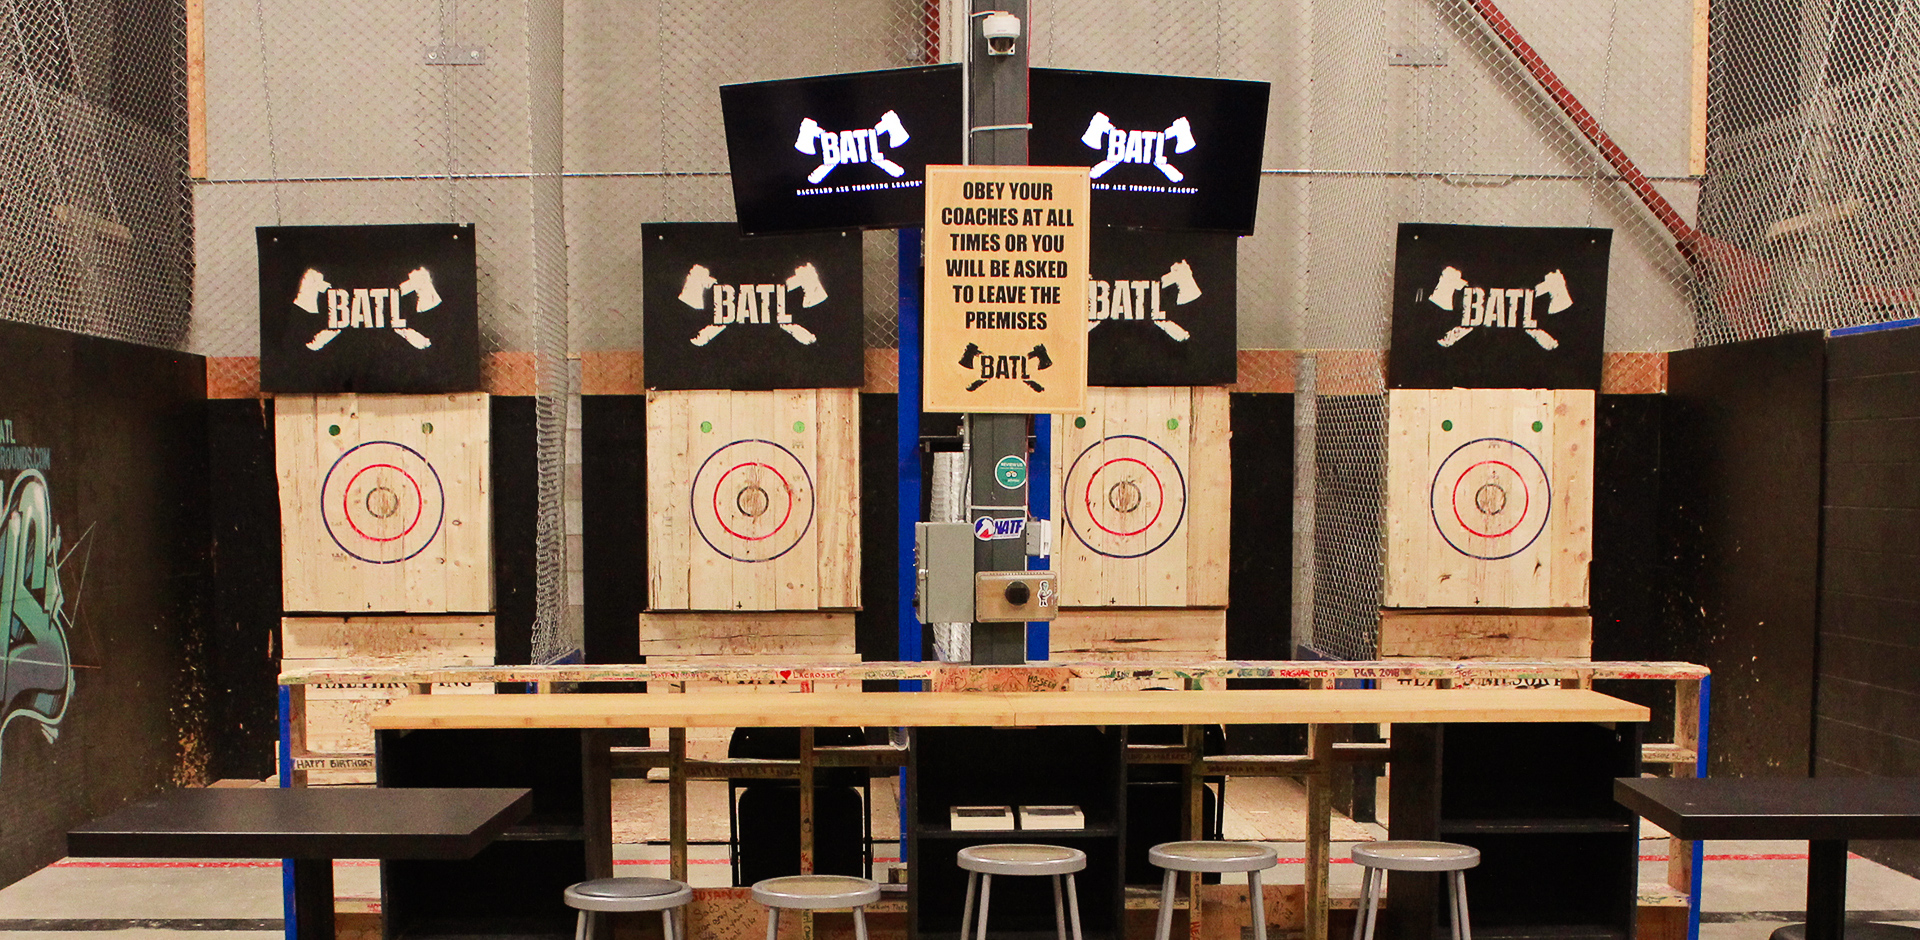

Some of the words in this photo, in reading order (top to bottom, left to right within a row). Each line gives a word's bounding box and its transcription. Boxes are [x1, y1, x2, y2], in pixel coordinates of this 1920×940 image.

[820, 129, 884, 165] BATL
[1106, 129, 1167, 164] BATL
[796, 187, 833, 196] BACKYARD
[835, 185, 849, 193] AXE
[852, 182, 889, 192] THROWING
[963, 182, 1004, 200] OBEY
[1009, 183, 1053, 200] YOUR
[1128, 185, 1165, 193] THROWING
[941, 207, 1018, 226] COACHES
[1022, 209, 1043, 226] AT
[1046, 209, 1074, 226] ALL
[949, 233, 1000, 252] TIMES
[1005, 234, 1027, 252] OR
[1032, 235, 1065, 252] YOU
[945, 259, 985, 277] WILL
[990, 260, 1009, 277] BE
[1013, 260, 1068, 278] ASKED
[953, 285, 974, 303] TO
[978, 286, 1026, 304] LEAVE
[1030, 286, 1061, 304] THE
[1088, 280, 1166, 320] BATL
[327, 288, 407, 329] BATL
[713, 284, 793, 325] BATL
[1461, 287, 1538, 328] BATL
[965, 311, 1047, 329] PREMISES
[980, 355, 1030, 379] BATL
[995, 520, 1023, 535] NATF
[1353, 668, 1377, 678] PGR
[1379, 668, 1400, 678] 2018
[296, 759, 325, 769] HAPPY
[330, 759, 373, 768] BIRTHDAY
[692, 890, 732, 901] SUSAN
